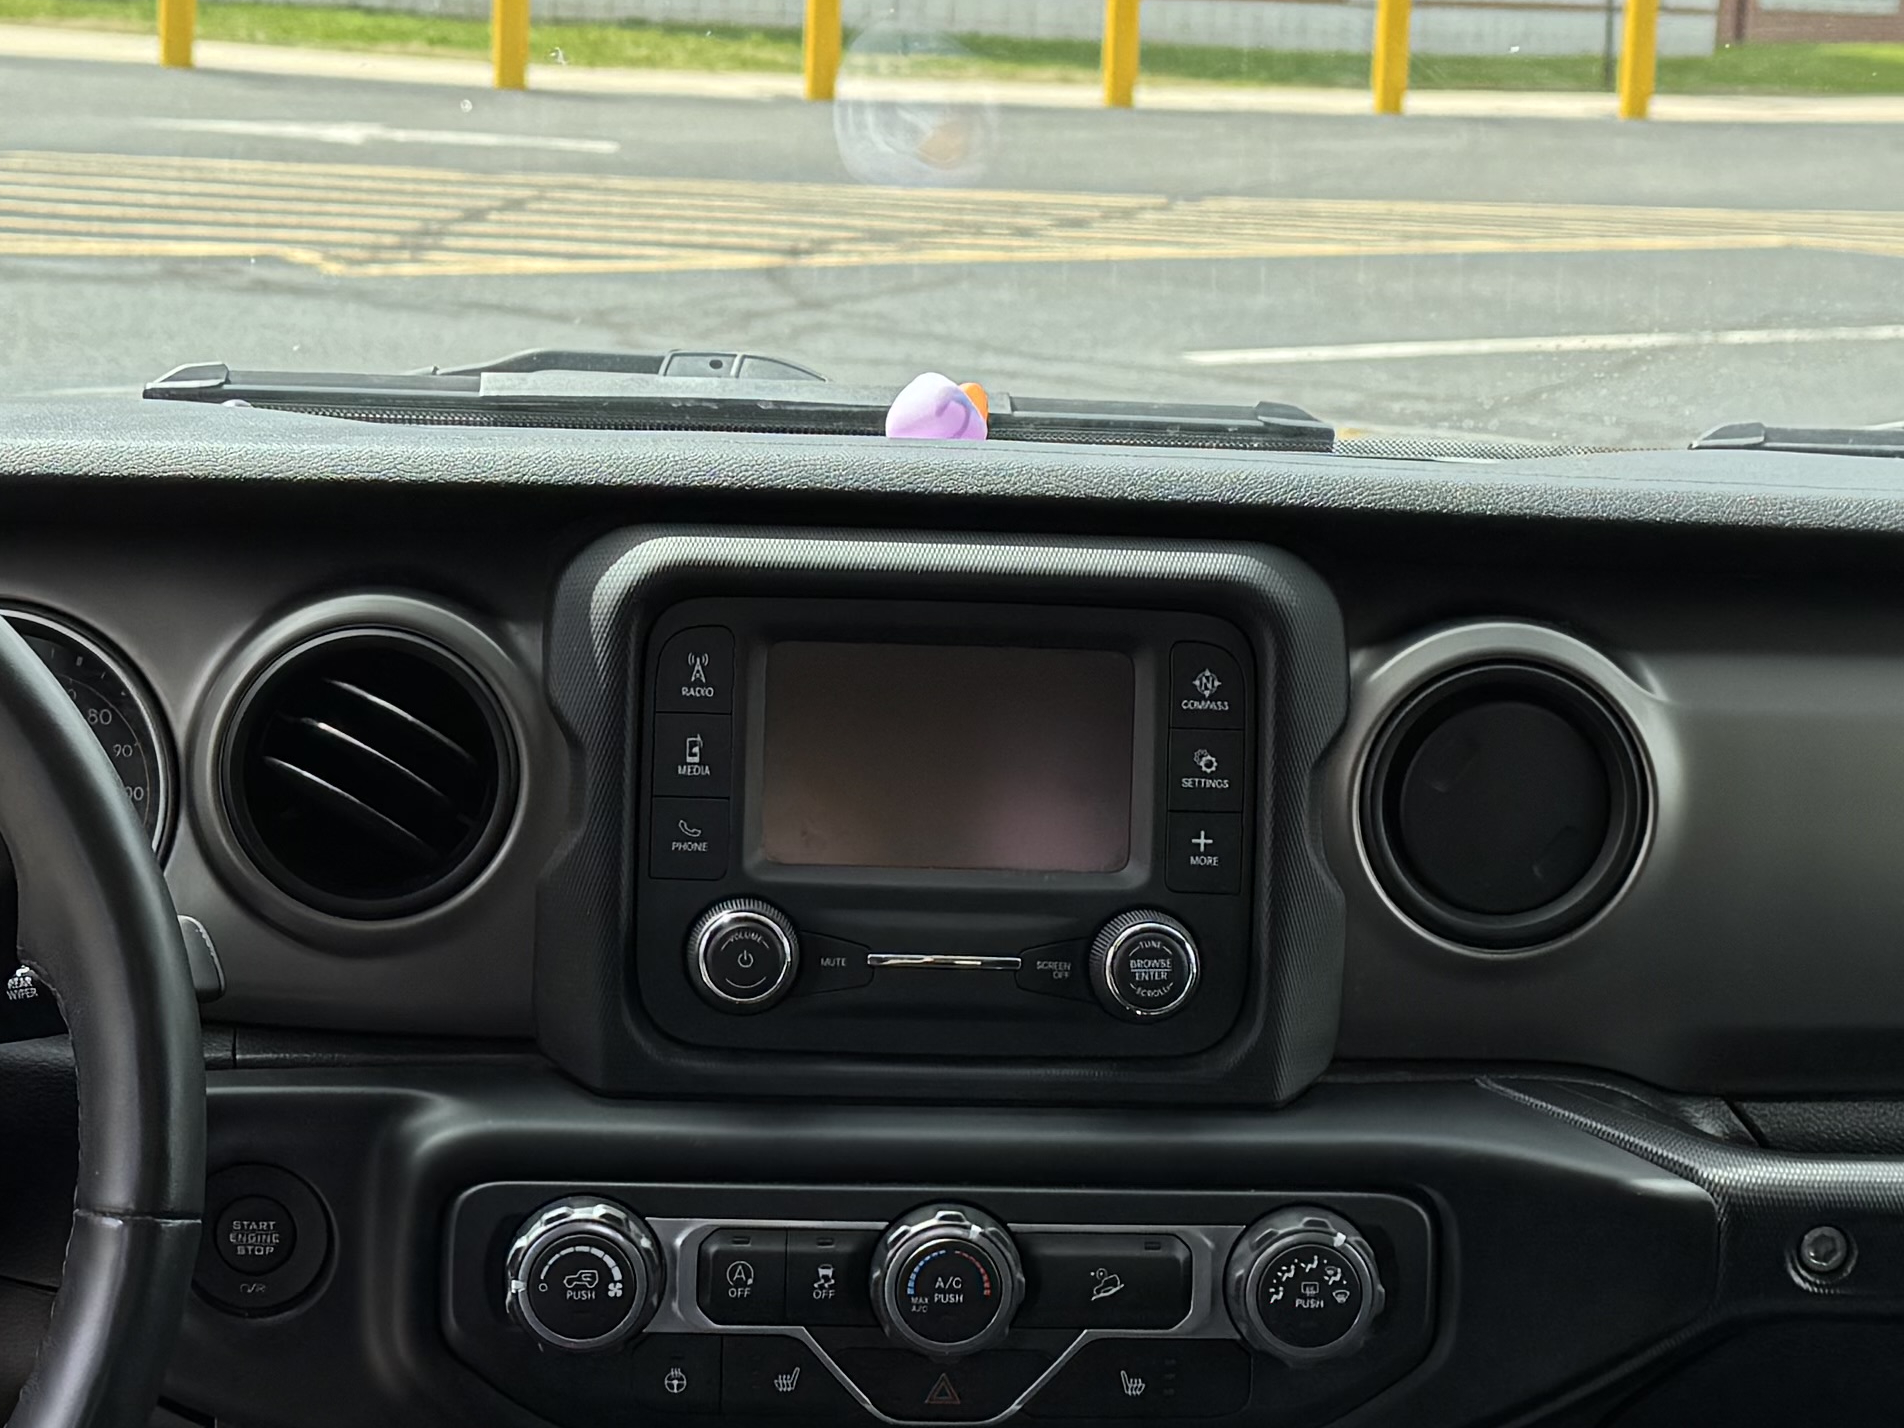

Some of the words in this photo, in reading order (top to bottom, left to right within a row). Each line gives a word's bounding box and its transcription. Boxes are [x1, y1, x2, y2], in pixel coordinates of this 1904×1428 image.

[681, 686, 714, 697] RADIO
[1180, 699, 1230, 711] COMPASS
[87, 708, 113, 725] 80
[112, 743, 133, 758] 90
[676, 764, 711, 776] MEDIA
[1180, 777, 1231, 789] SETTINGS
[671, 841, 709, 852] PHONE
[1189, 855, 1219, 867] MORE
[728, 930, 764, 944] VOLUME
[1139, 939, 1162, 949] TUNE
[820, 956, 847, 967] MUTE
[1035, 960, 1072, 971] SCREEN
[1129, 958, 1172, 970] BROWSE
[1052, 970, 1070, 980] OFF
[1134, 970, 1169, 981] ENTER
[232, 1220, 277, 1231] START
[228, 1232, 281, 1243] ENGINE
[236, 1245, 275, 1255] STOP
[934, 1275, 963, 1290] A/C
[566, 1289, 596, 1300] PUSH
[728, 1287, 752, 1298] OFF
[812, 1289, 837, 1300] OFF
[933, 1292, 964, 1304] PUSH
[1295, 1297, 1325, 1309] PUSH
